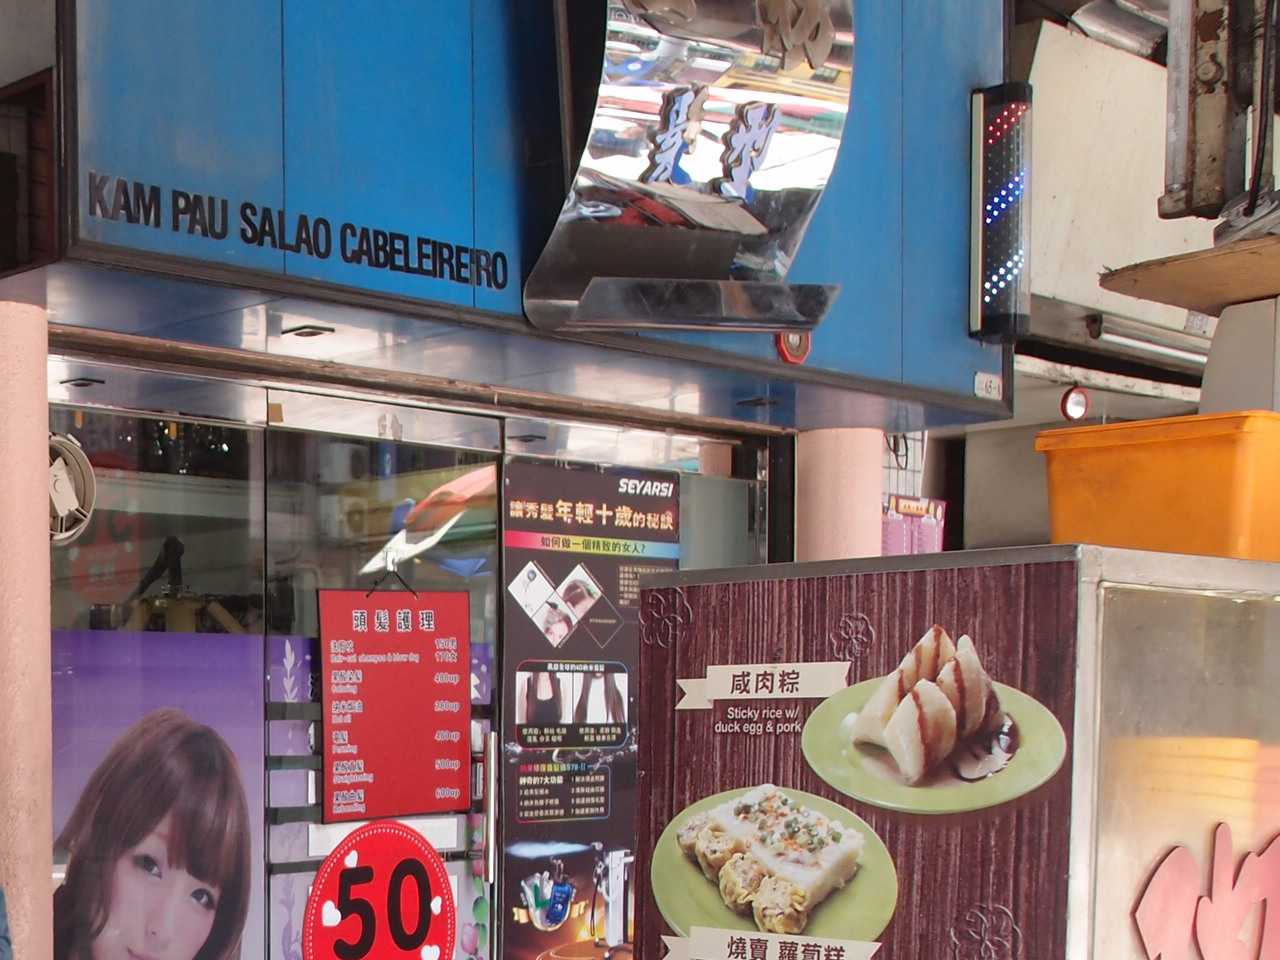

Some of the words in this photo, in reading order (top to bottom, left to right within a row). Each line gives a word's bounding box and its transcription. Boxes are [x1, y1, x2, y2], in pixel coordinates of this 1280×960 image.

[89, 172, 160, 228] KAM
[172, 191, 228, 240] PAU
[239, 202, 331, 258] SALAO
[340, 223, 508, 290] CABELEIREIRO
[619, 478, 673, 497] SEYARSI
[353, 610, 436, 632] 頭髮護理
[730, 669, 801, 695] 咸肉粽
[727, 707, 759, 721] Sticky
[762, 707, 782, 719] rice
[785, 706, 800, 719] w/
[715, 721, 740, 733] duck
[743, 723, 763, 735] egg
[766, 721, 774, 733] &
[776, 721, 802, 735] pork
